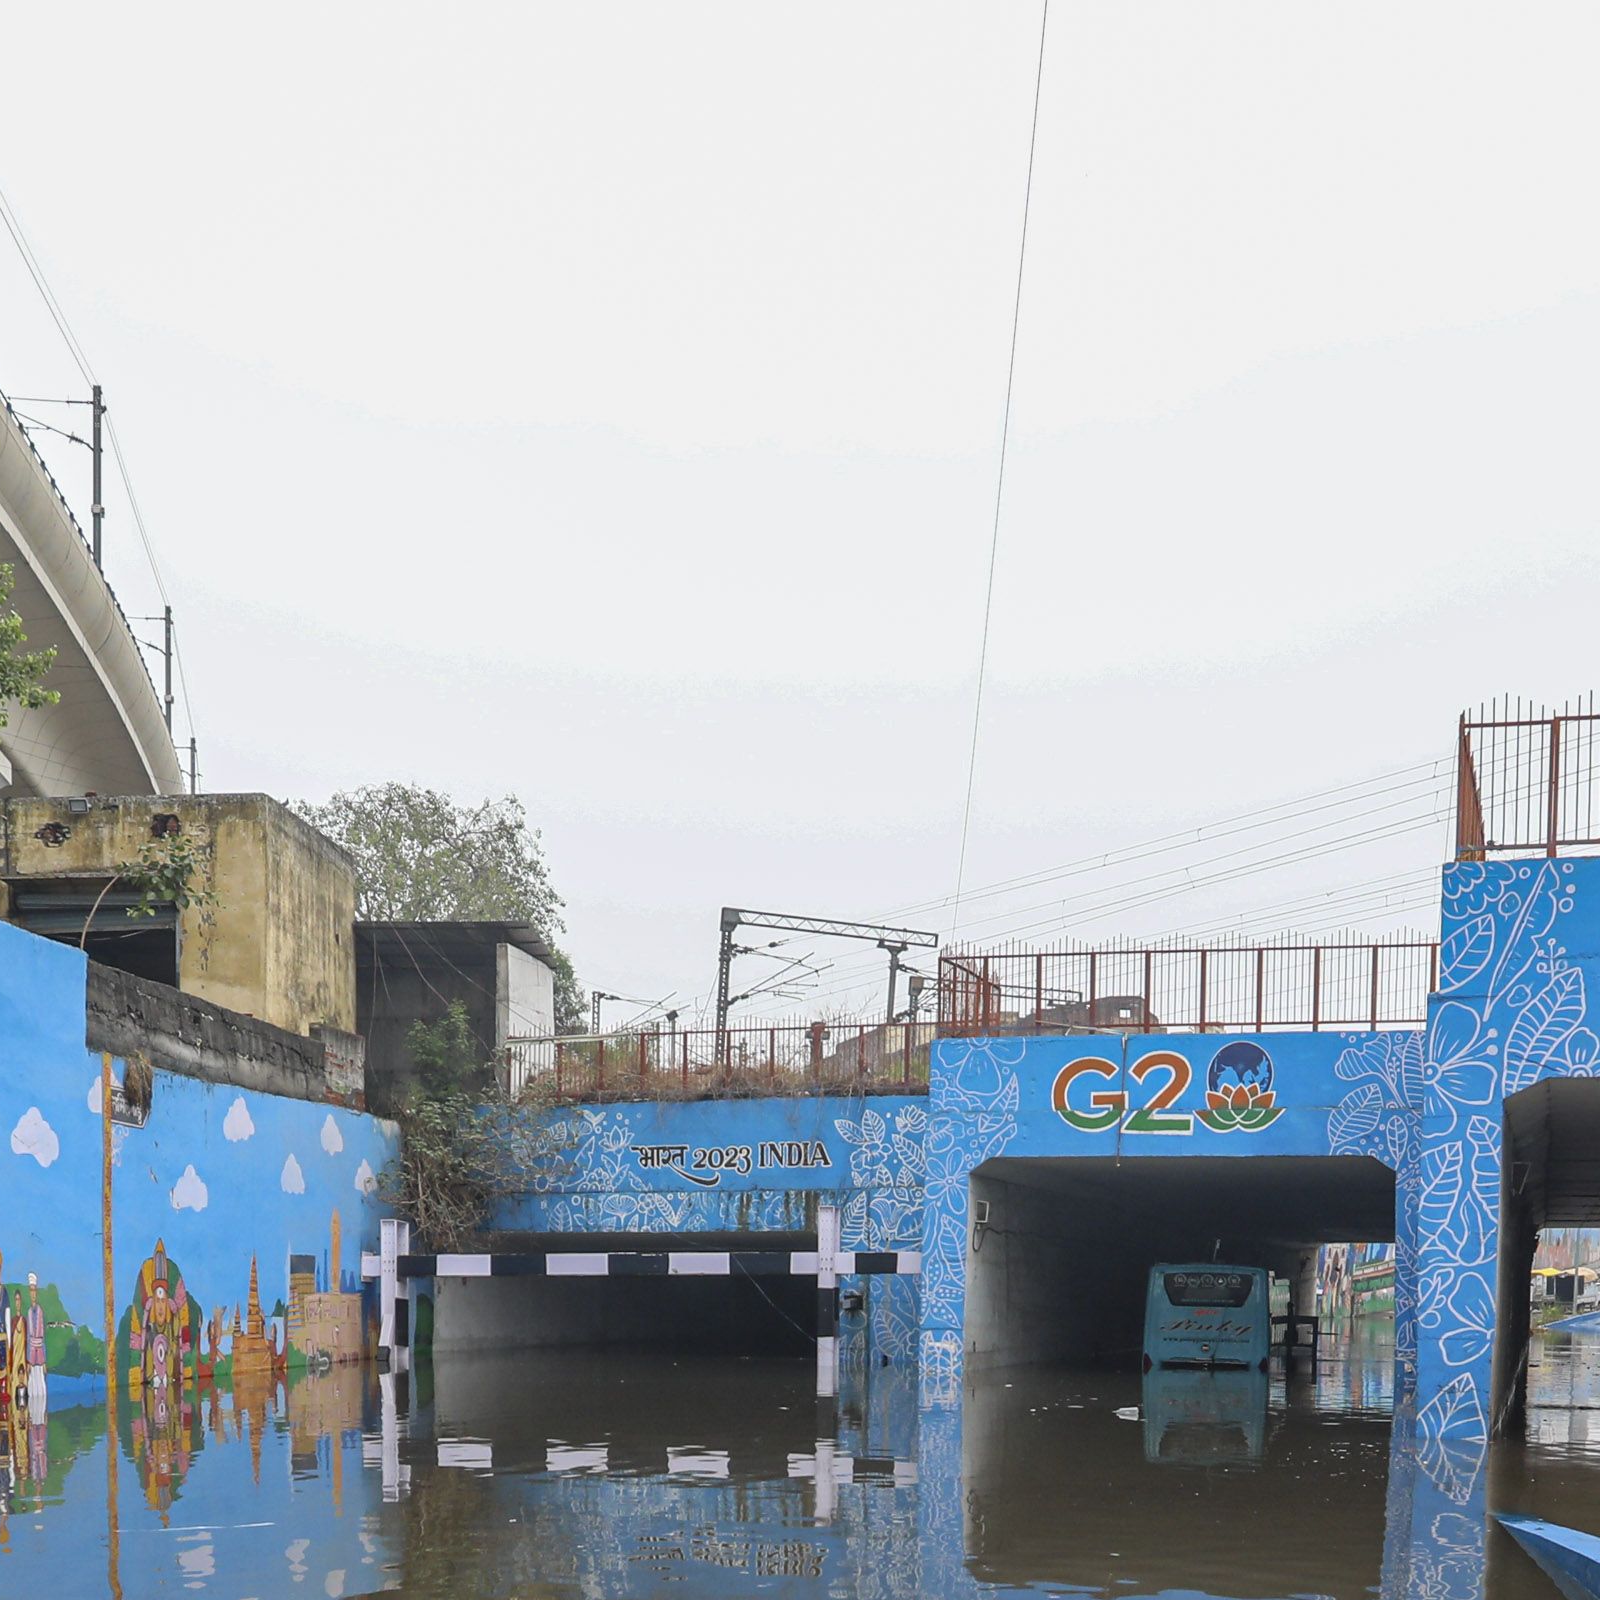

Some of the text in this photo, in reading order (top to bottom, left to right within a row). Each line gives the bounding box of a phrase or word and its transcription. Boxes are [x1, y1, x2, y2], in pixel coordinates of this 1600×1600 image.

[630, 1141, 832, 1187] भारत 2023 INDIA
